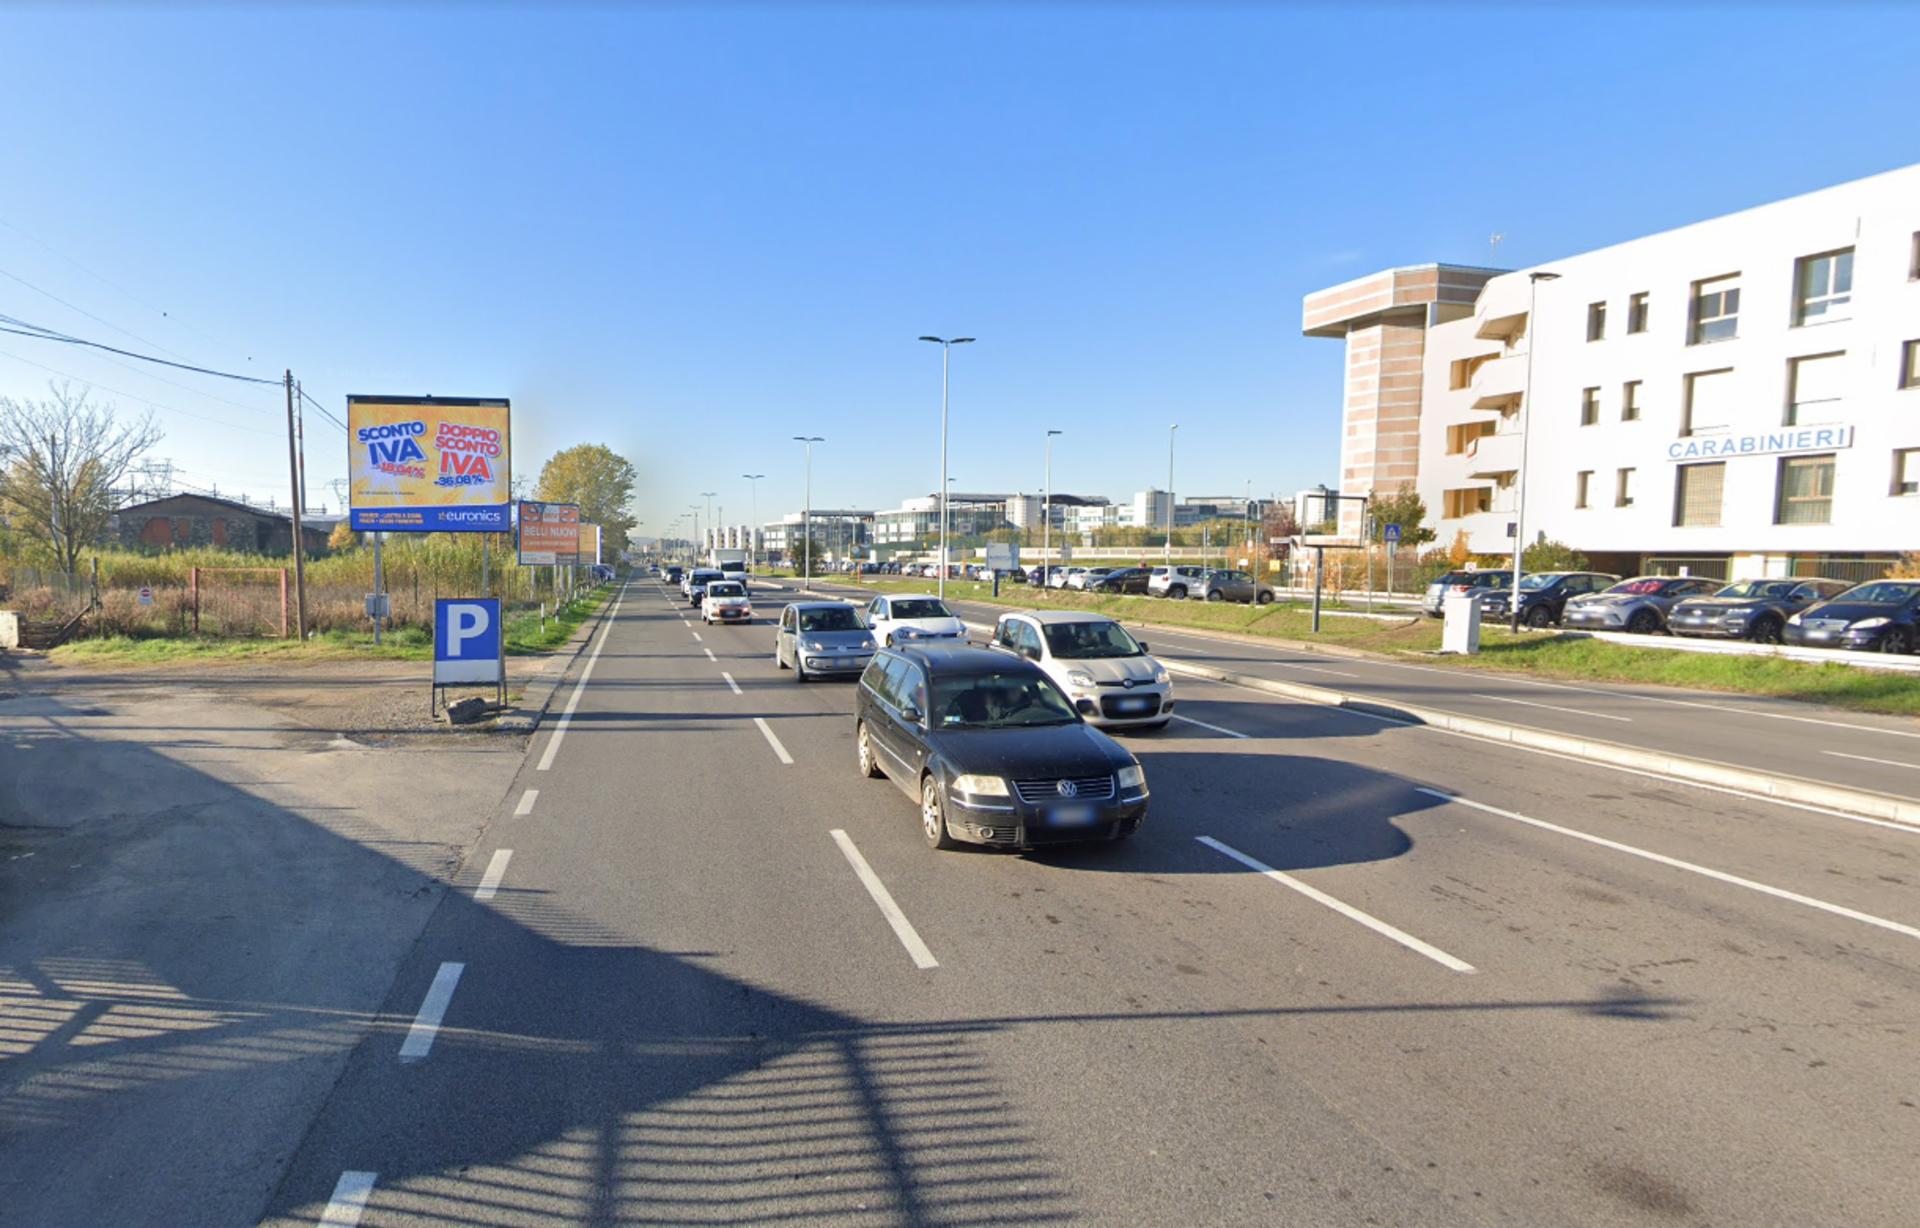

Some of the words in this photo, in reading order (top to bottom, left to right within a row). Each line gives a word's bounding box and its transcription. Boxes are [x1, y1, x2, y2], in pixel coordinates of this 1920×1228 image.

[358, 421, 425, 442] SCONTO
[439, 423, 498, 442] DOPPIO
[368, 438, 424, 465] IVA
[435, 436, 500, 455] SCONTO
[1668, 428, 1845, 458] CARABINIERI
[440, 452, 490, 479] IVA
[446, 509, 501, 522] euronics
[524, 526, 548, 537] BELLI
[447, 604, 489, 656] P
